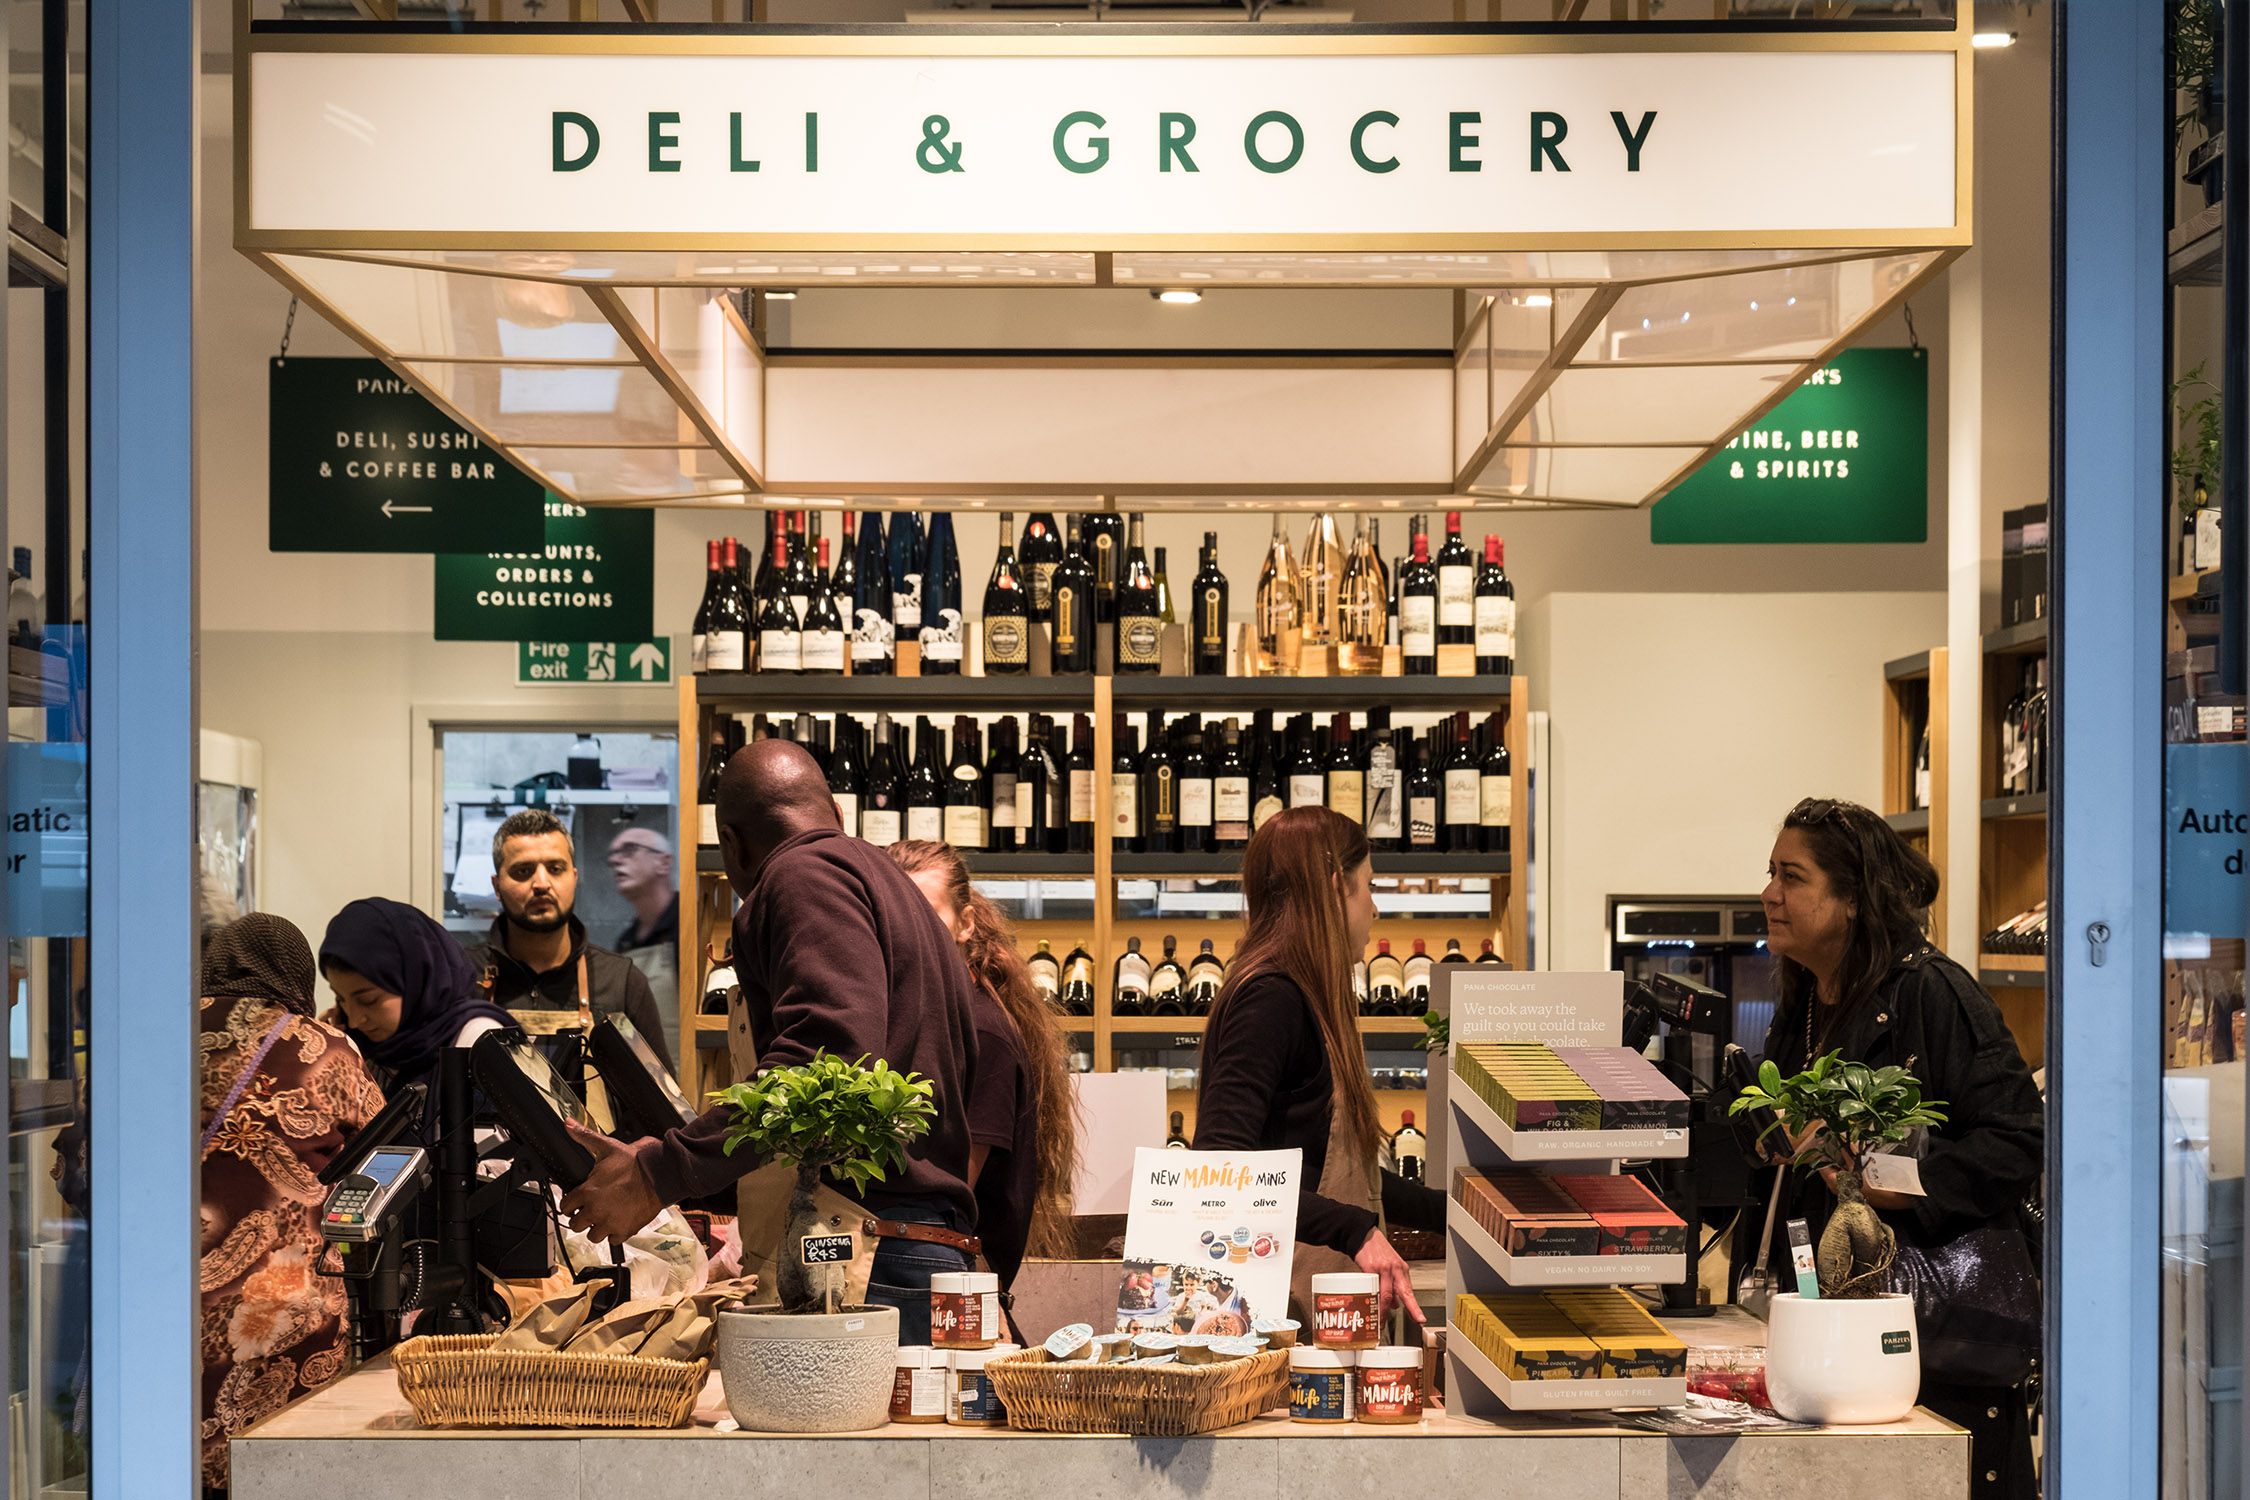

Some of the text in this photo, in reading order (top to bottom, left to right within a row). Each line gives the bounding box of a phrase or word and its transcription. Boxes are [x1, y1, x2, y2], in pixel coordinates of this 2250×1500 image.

[552, 110, 1657, 174] DELI & GROCERY
[336, 431, 479, 451] DELI, SUSHI
[1801, 430, 1859, 449] BEER
[319, 461, 495, 479] & COFFEE BAR
[1729, 459, 1849, 479] & SPIRITS
[496, 567, 594, 584] ORDERS &
[476, 591, 613, 608] COLLECTIONS
[528, 641, 570, 657] Fire
[529, 660, 568, 679] exit
[7, 806, 71, 832] atic
[1463, 1002, 1577, 1019] We took away the
[1463, 1019, 1606, 1035] guilt so you could take
[1547, 1120, 1570, 1128] FIG &
[1621, 1122, 1668, 1130] CINNAMON
[1562, 1141, 1603, 1149] ORGANIC.
[1606, 1140, 1655, 1148] HANDMADE
[1150, 1170, 1180, 1185] NEW
[1201, 1200, 1226, 1208] METRO
[1253, 1198, 1277, 1207] olive
[1613, 1244, 1672, 1253] STRAWBERRY
[1545, 1266, 1575, 1274] VEGAN.
[1578, 1266, 1590, 1274] NO
[1620, 1265, 1633, 1273] NO
[1635, 1265, 1653, 1273] SOY.
[1532, 1369, 1580, 1377] PINEAPPLE
[1620, 1367, 1667, 1376] PINEAPPLE
[1543, 1390, 1576, 1398] GLUTEN
[1604, 1389, 1629, 1397] GUILT
